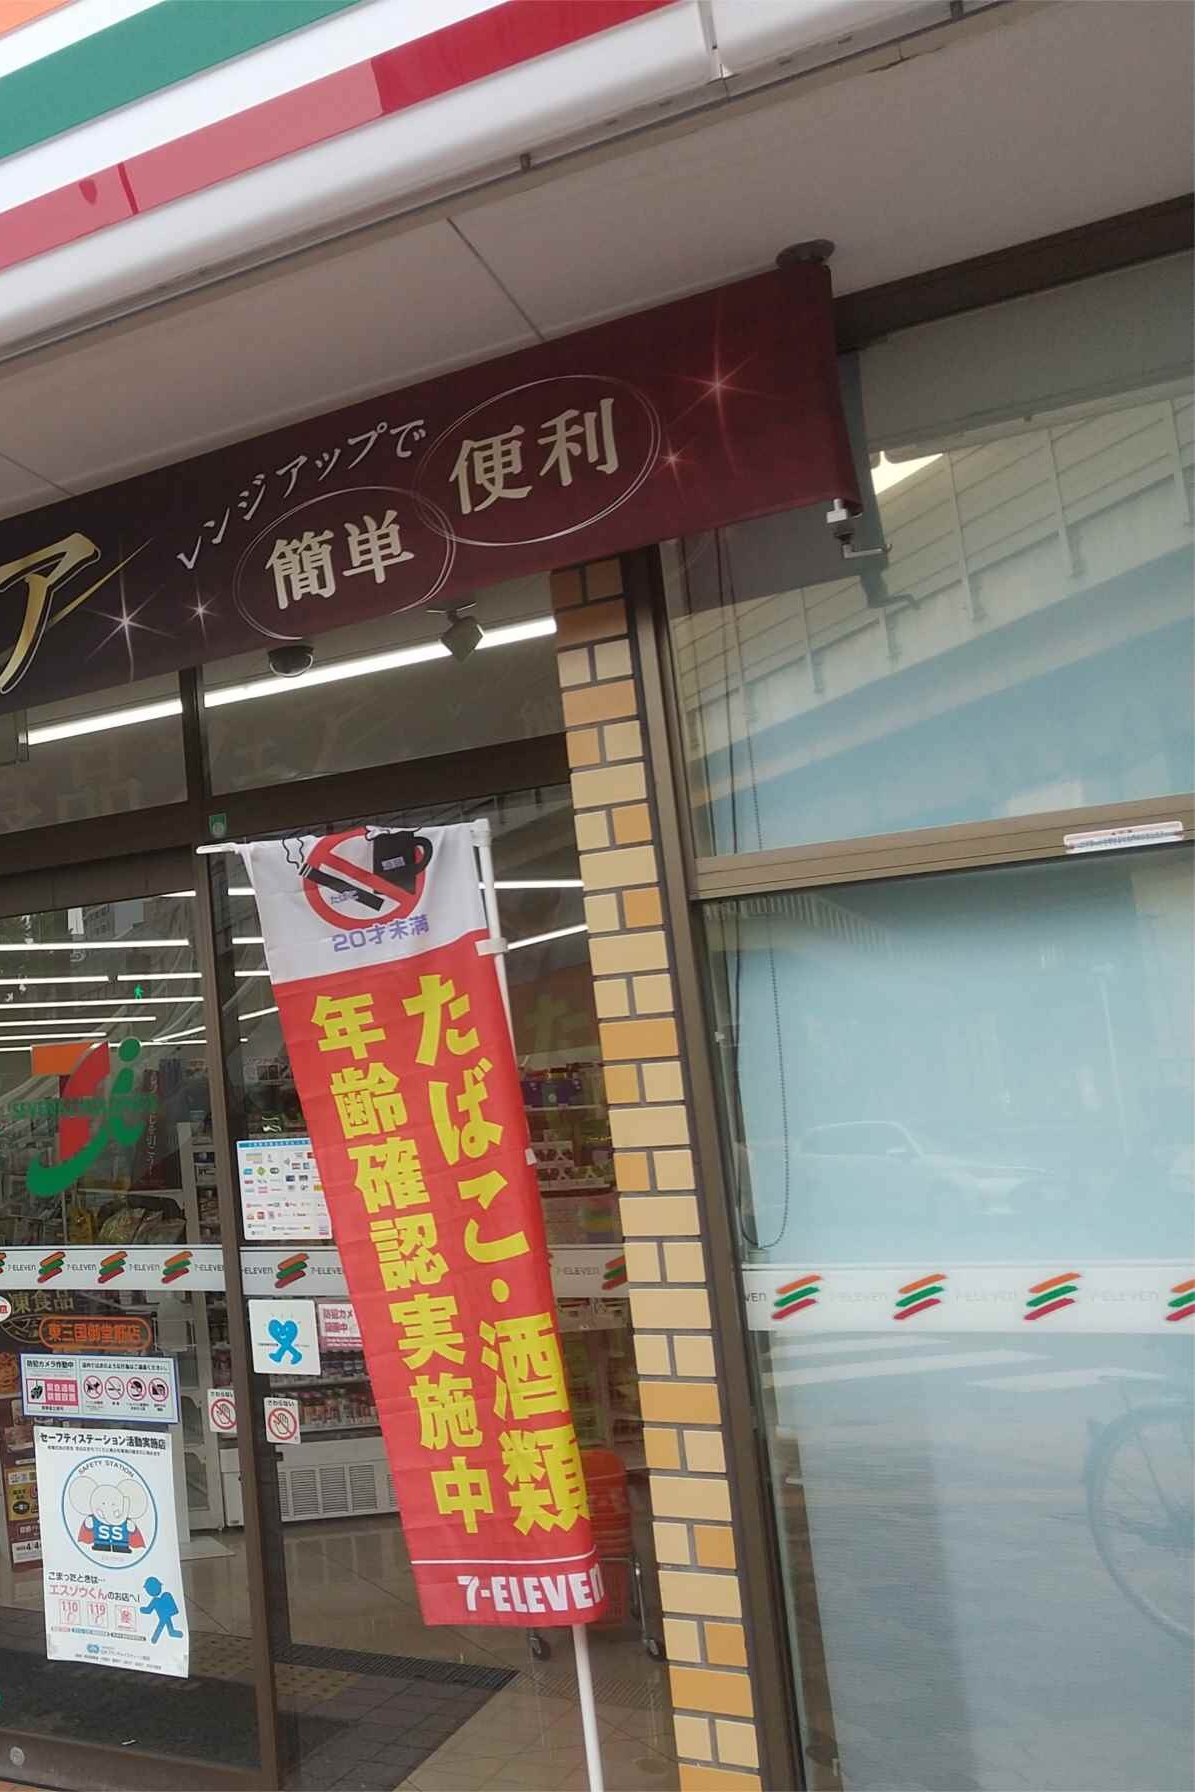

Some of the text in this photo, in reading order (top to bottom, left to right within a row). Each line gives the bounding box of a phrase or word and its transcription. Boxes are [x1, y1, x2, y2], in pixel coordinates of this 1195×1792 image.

[176, 420, 428, 571] レンジアップで
[448, 398, 623, 514] 便利
[265, 509, 415, 610] 簡単
[331, 914, 430, 953] 20才未満
[311, 992, 495, 1534] 年齢確認実施中
[402, 974, 591, 1536] たばこ・酒類
[77, 1459, 135, 1478] SAFETY STATION
[98, 1525, 124, 1541] SS
